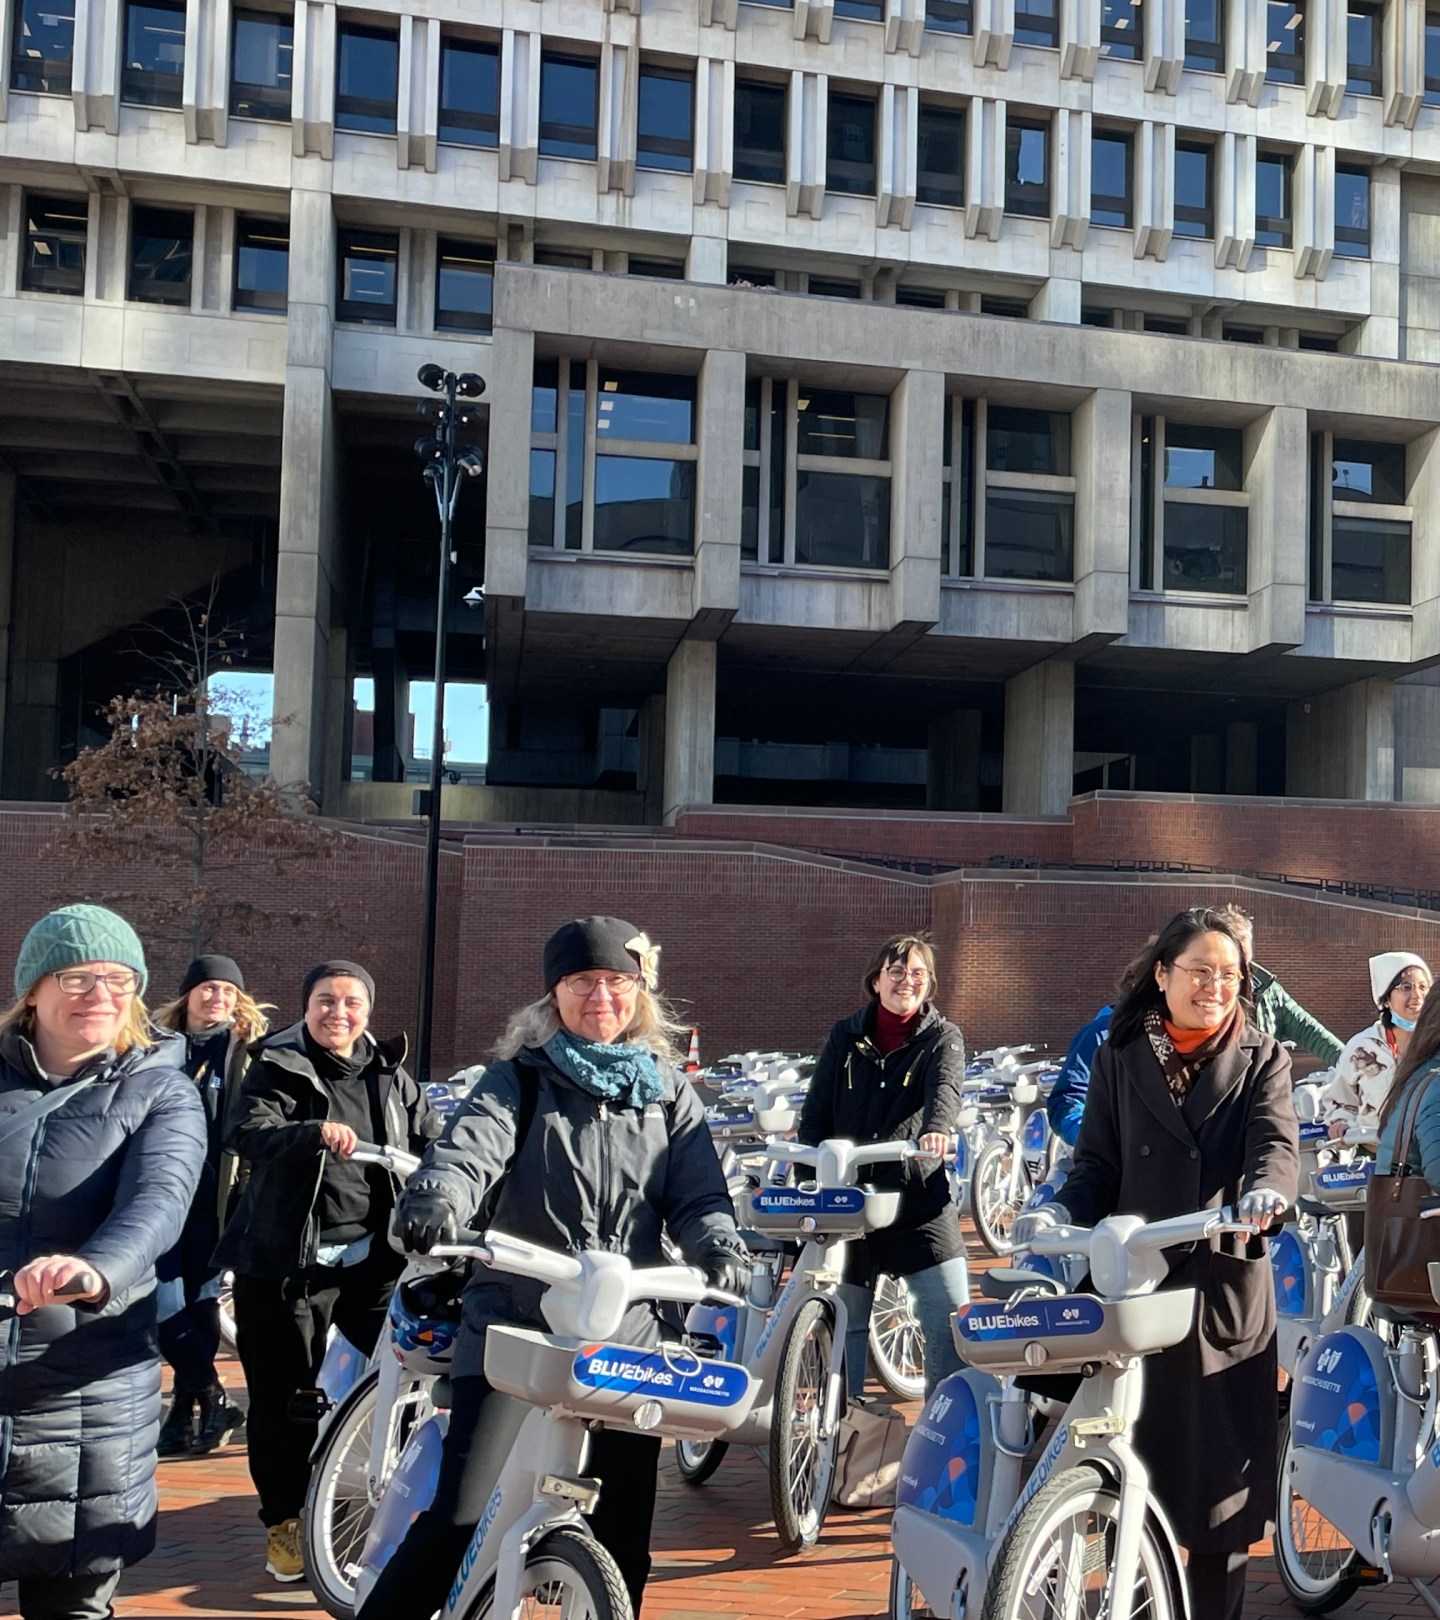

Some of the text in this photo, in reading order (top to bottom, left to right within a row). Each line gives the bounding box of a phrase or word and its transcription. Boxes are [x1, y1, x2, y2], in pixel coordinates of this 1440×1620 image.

[1322, 1171, 1366, 1184] BLUEbikes
[760, 1196, 816, 1207] BLUEbikes
[968, 1313, 1042, 1331] BLUEbikes
[588, 1357, 674, 1387] BLUEbikes
